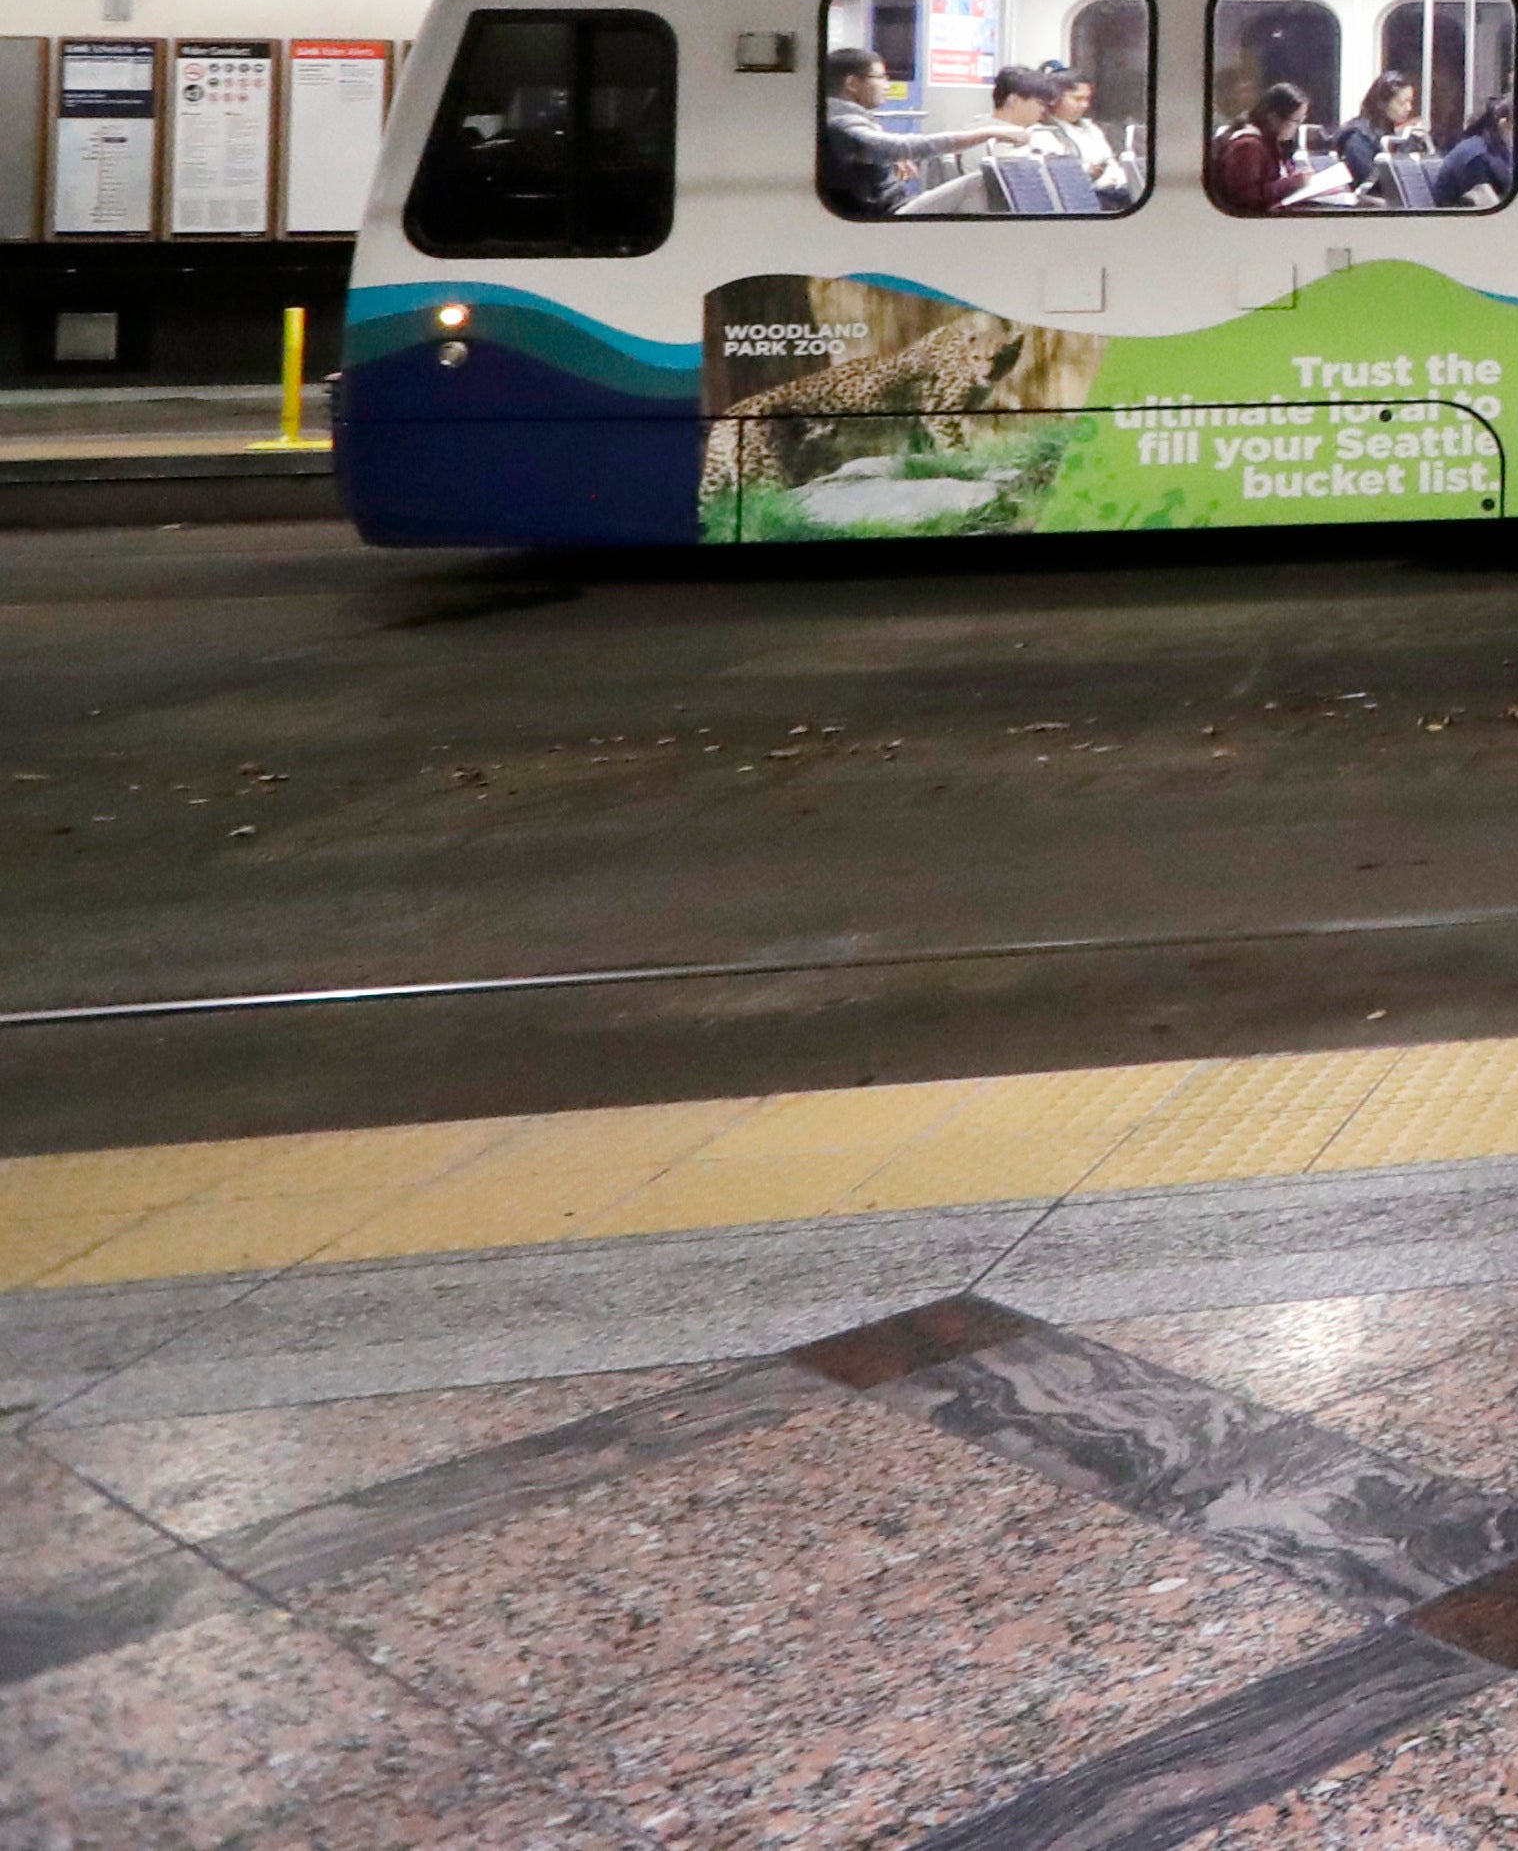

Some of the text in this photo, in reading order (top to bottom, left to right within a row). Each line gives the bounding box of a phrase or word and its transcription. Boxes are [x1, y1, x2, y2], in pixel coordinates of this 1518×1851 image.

[724, 323, 869, 340] WOODLAND
[724, 339, 846, 357] PARK ZOO
[1291, 352, 1501, 389] Trust the
[1113, 395, 1315, 429] ultimate
[1453, 389, 1501, 422] to
[1138, 423, 1502, 470] fill your Seattle
[1243, 459, 1502, 500] bucket list.
